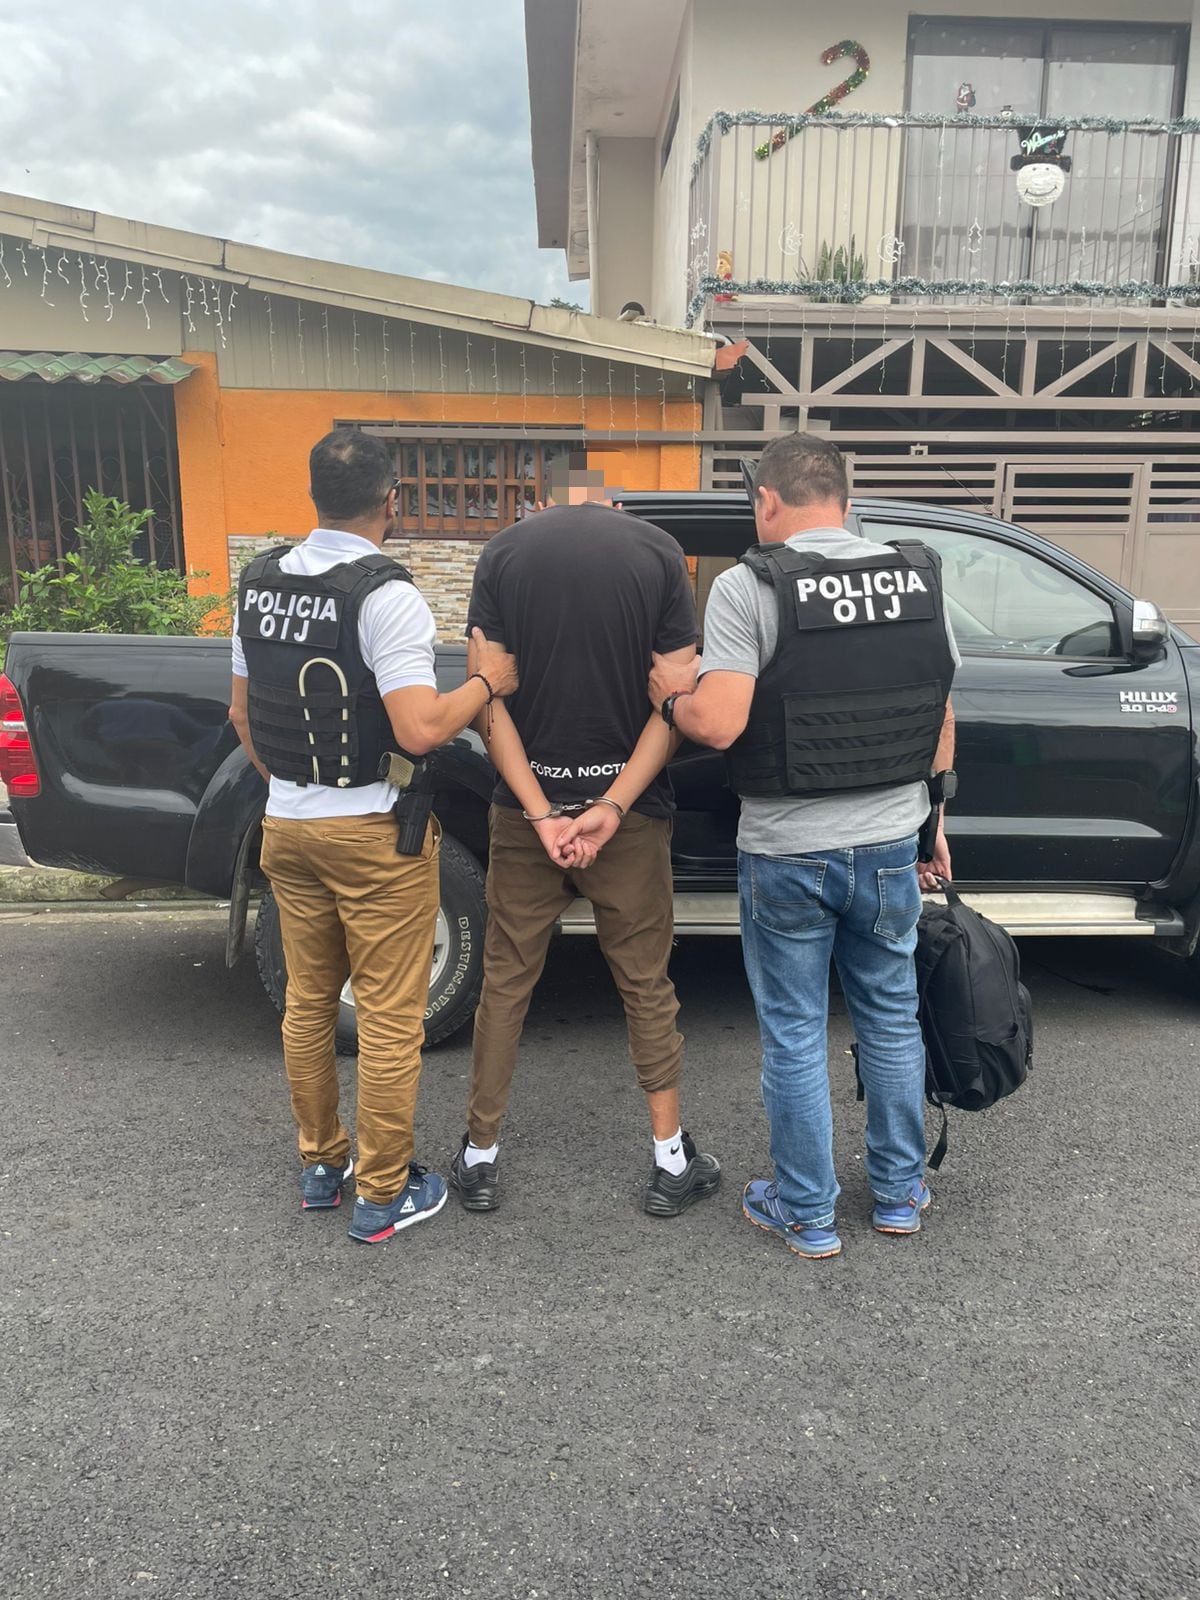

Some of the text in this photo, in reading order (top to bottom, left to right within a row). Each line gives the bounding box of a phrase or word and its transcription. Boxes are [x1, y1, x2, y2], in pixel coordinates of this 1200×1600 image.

[797, 571, 928, 602] POLICIA
[244, 589, 337, 622] POLICIA
[1119, 691, 1178, 703] HILUX
[530, 760, 573, 779] FORZA
